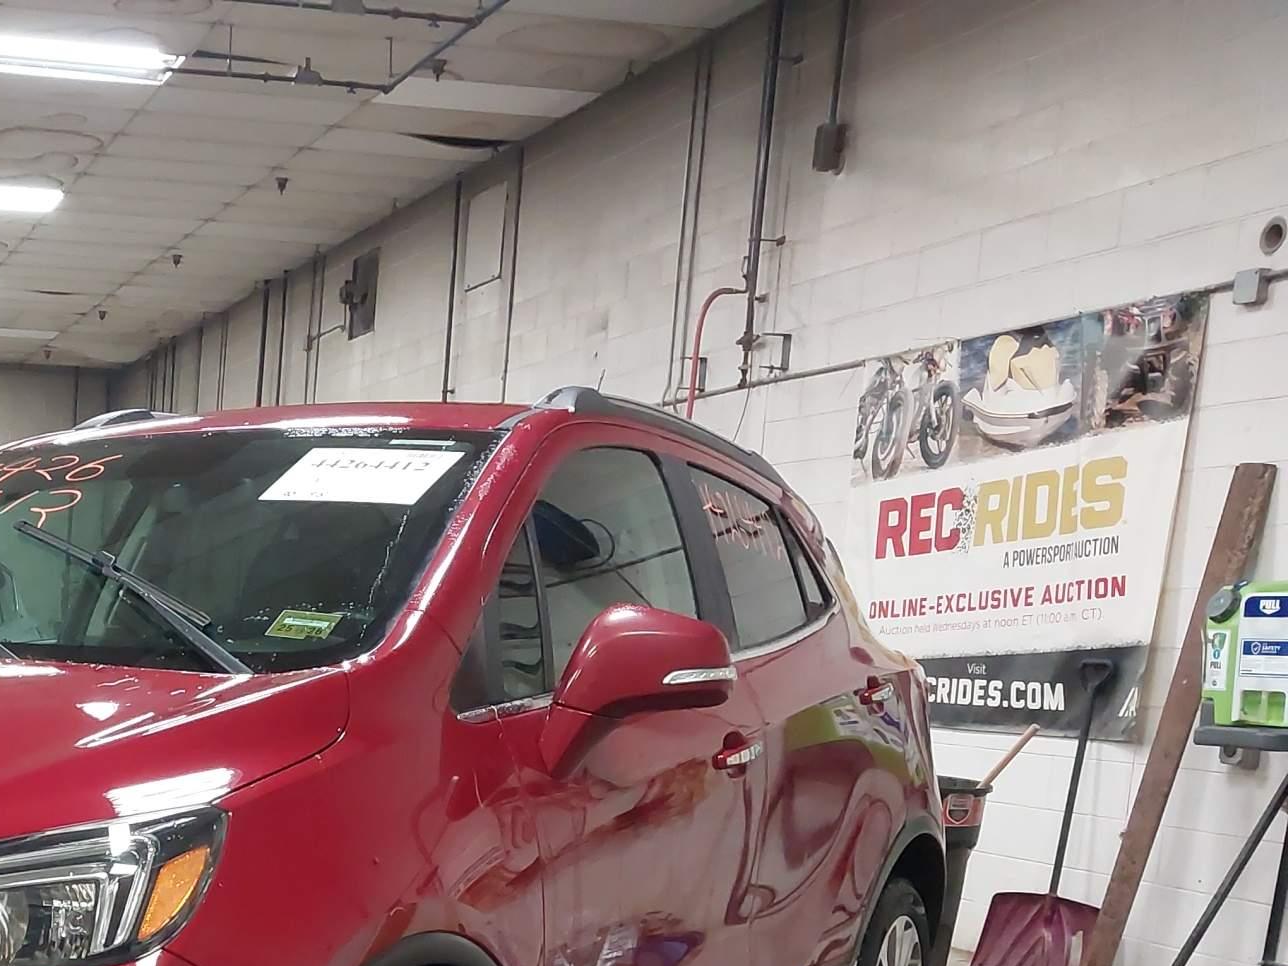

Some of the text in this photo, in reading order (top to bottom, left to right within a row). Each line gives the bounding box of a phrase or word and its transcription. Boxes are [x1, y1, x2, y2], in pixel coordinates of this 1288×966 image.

[875, 487, 964, 559] REC
[973, 456, 1127, 547] RIDES
[1003, 551, 1009, 568] A
[869, 575, 1127, 619] ONLINE-EXCLUSIVE AUCTION
[994, 616, 1019, 627] noon
[966, 663, 987, 675] Visit
[927, 676, 1065, 711] CRIDES.COM
